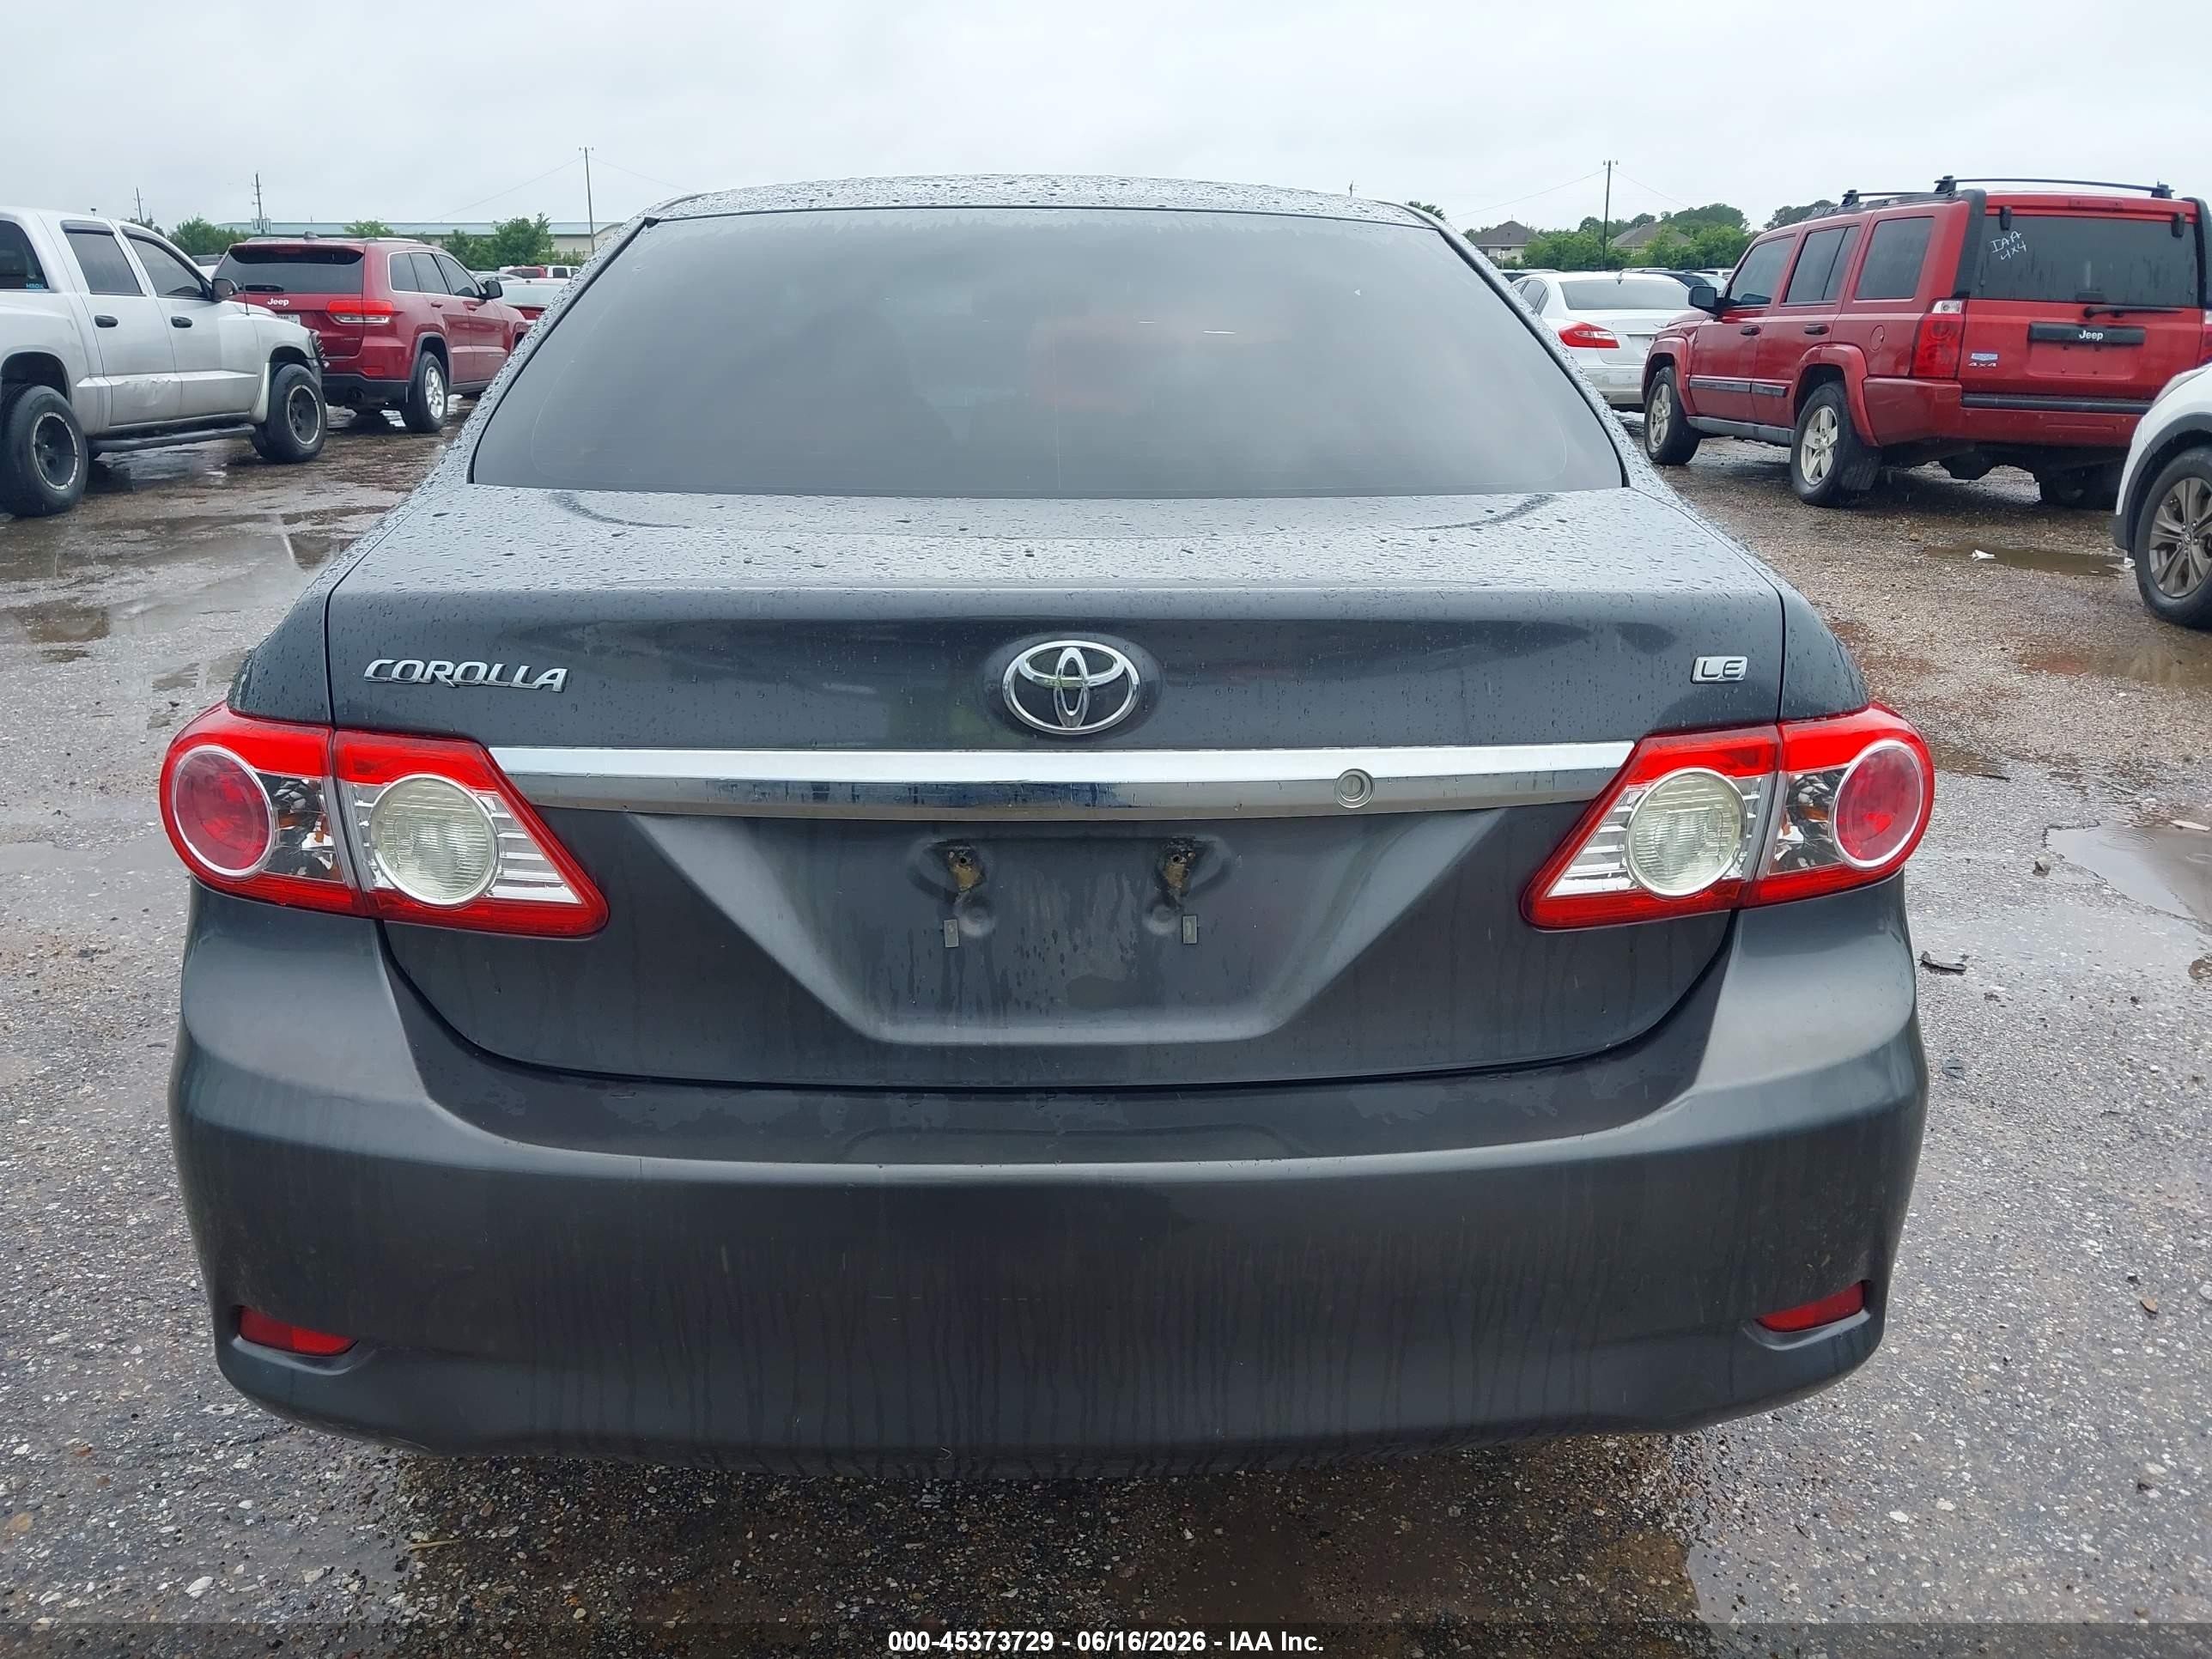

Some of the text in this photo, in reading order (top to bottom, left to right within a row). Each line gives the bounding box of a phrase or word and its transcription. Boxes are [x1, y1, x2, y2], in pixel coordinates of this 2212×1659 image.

[1990, 230, 2022, 253] IAA
[267, 297, 289, 307] Jeep
[2078, 330, 2104, 342] Jeep
[363, 659, 569, 694] COROLLA
[1699, 659, 1744, 679] LE
